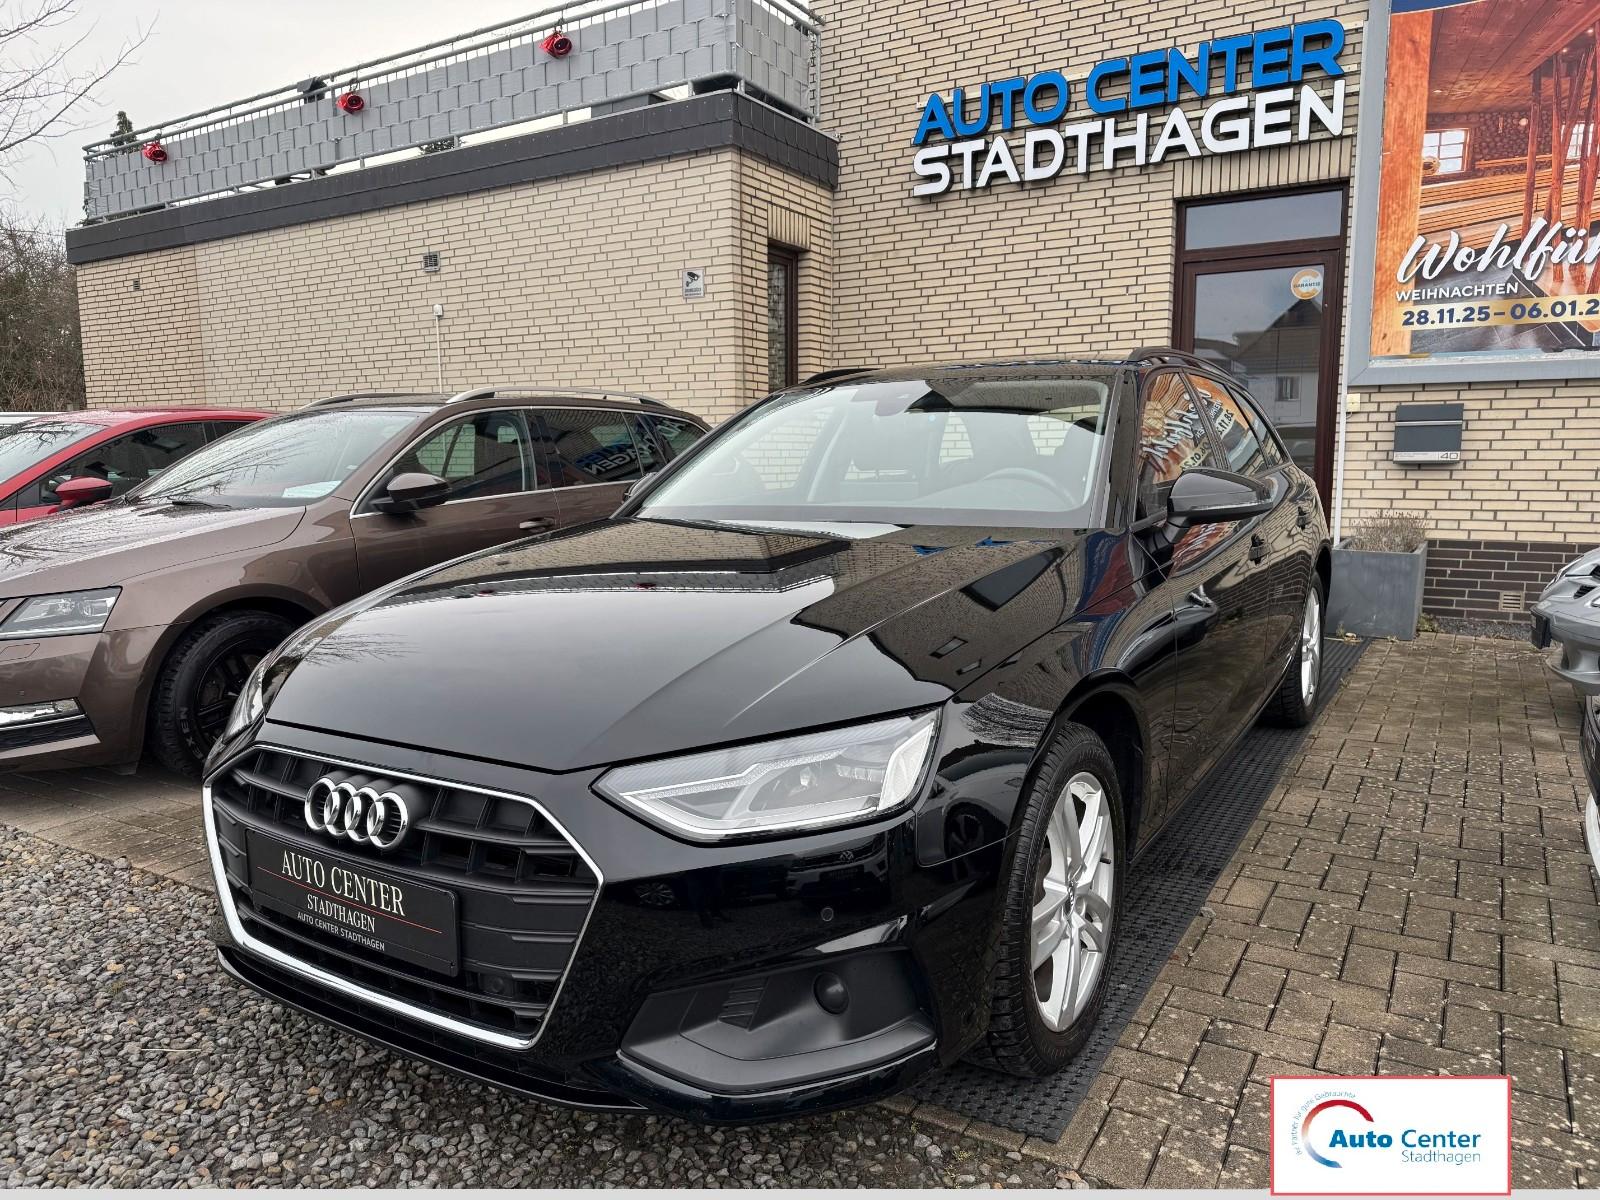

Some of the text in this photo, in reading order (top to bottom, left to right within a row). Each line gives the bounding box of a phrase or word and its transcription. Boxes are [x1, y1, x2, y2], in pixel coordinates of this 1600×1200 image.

[912, 18, 1346, 145] AUTO CENTER
[912, 79, 1346, 197] STADTHAGEN
[1396, 282, 1519, 301] WEIHNACHTEN
[1402, 306, 1490, 326] 28.11.25
[282, 850, 405, 916] AUTO CENTER
[297, 912, 385, 951] AUTO CENTER STADTHAGEN
[307, 894, 375, 933] STADTHAGEN
